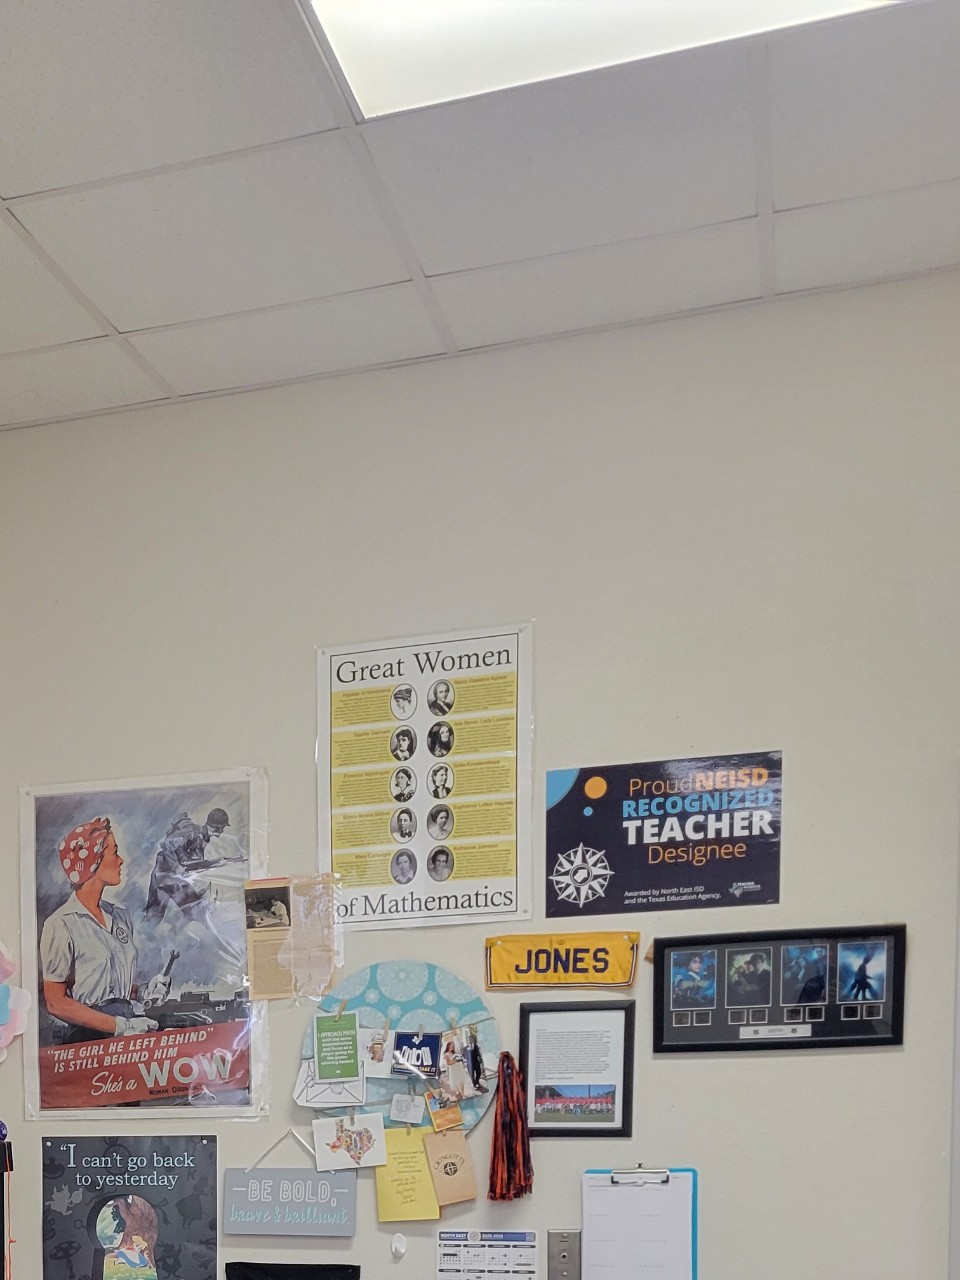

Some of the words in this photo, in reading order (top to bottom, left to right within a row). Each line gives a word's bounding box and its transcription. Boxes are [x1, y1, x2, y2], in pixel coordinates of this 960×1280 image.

[336, 658, 405, 684] Great
[412, 648, 512, 675] Women
[629, 774, 695, 797] Proud
[695, 767, 769, 791] NEISD
[622, 788, 774, 818] RECOGNIZED
[622, 810, 774, 845] TEACHER
[648, 843, 747, 866] Designee
[336, 897, 358, 918] of
[361, 885, 513, 916] Mathematics
[624, 897, 636, 905] and
[637, 896, 647, 904] the
[648, 895, 666, 903] Texas
[666, 893, 697, 902] Education
[651, 889, 660, 897] by
[660, 887, 679, 895] North
[515, 948, 609, 974] JONES
[54, 1062, 65, 1073] IS
[68, 1057, 99, 1072] STILL
[103, 1051, 149, 1067] BEHIND
[153, 1047, 179, 1060] HIM
[79, 1044, 104, 1058] GIRL
[108, 1041, 124, 1054] HE
[129, 1036, 156, 1051] LEFT
[91, 1071, 123, 1096] She's
[125, 1080, 138, 1090] a
[138, 1050, 233, 1088] WOW
[149, 1088, 169, 1096] WOMAN
[82, 1153, 123, 1168] can't
[128, 1156, 147, 1171] go
[153, 1152, 195, 1168] back
[76, 1172, 91, 1186] to
[96, 1171, 179, 1189] yesterday
[248, 1180, 273, 1202] BE
[280, 1180, 337, 1207] BOLD,
[230, 1203, 272, 1223] brave
[273, 1205, 282, 1223] &
